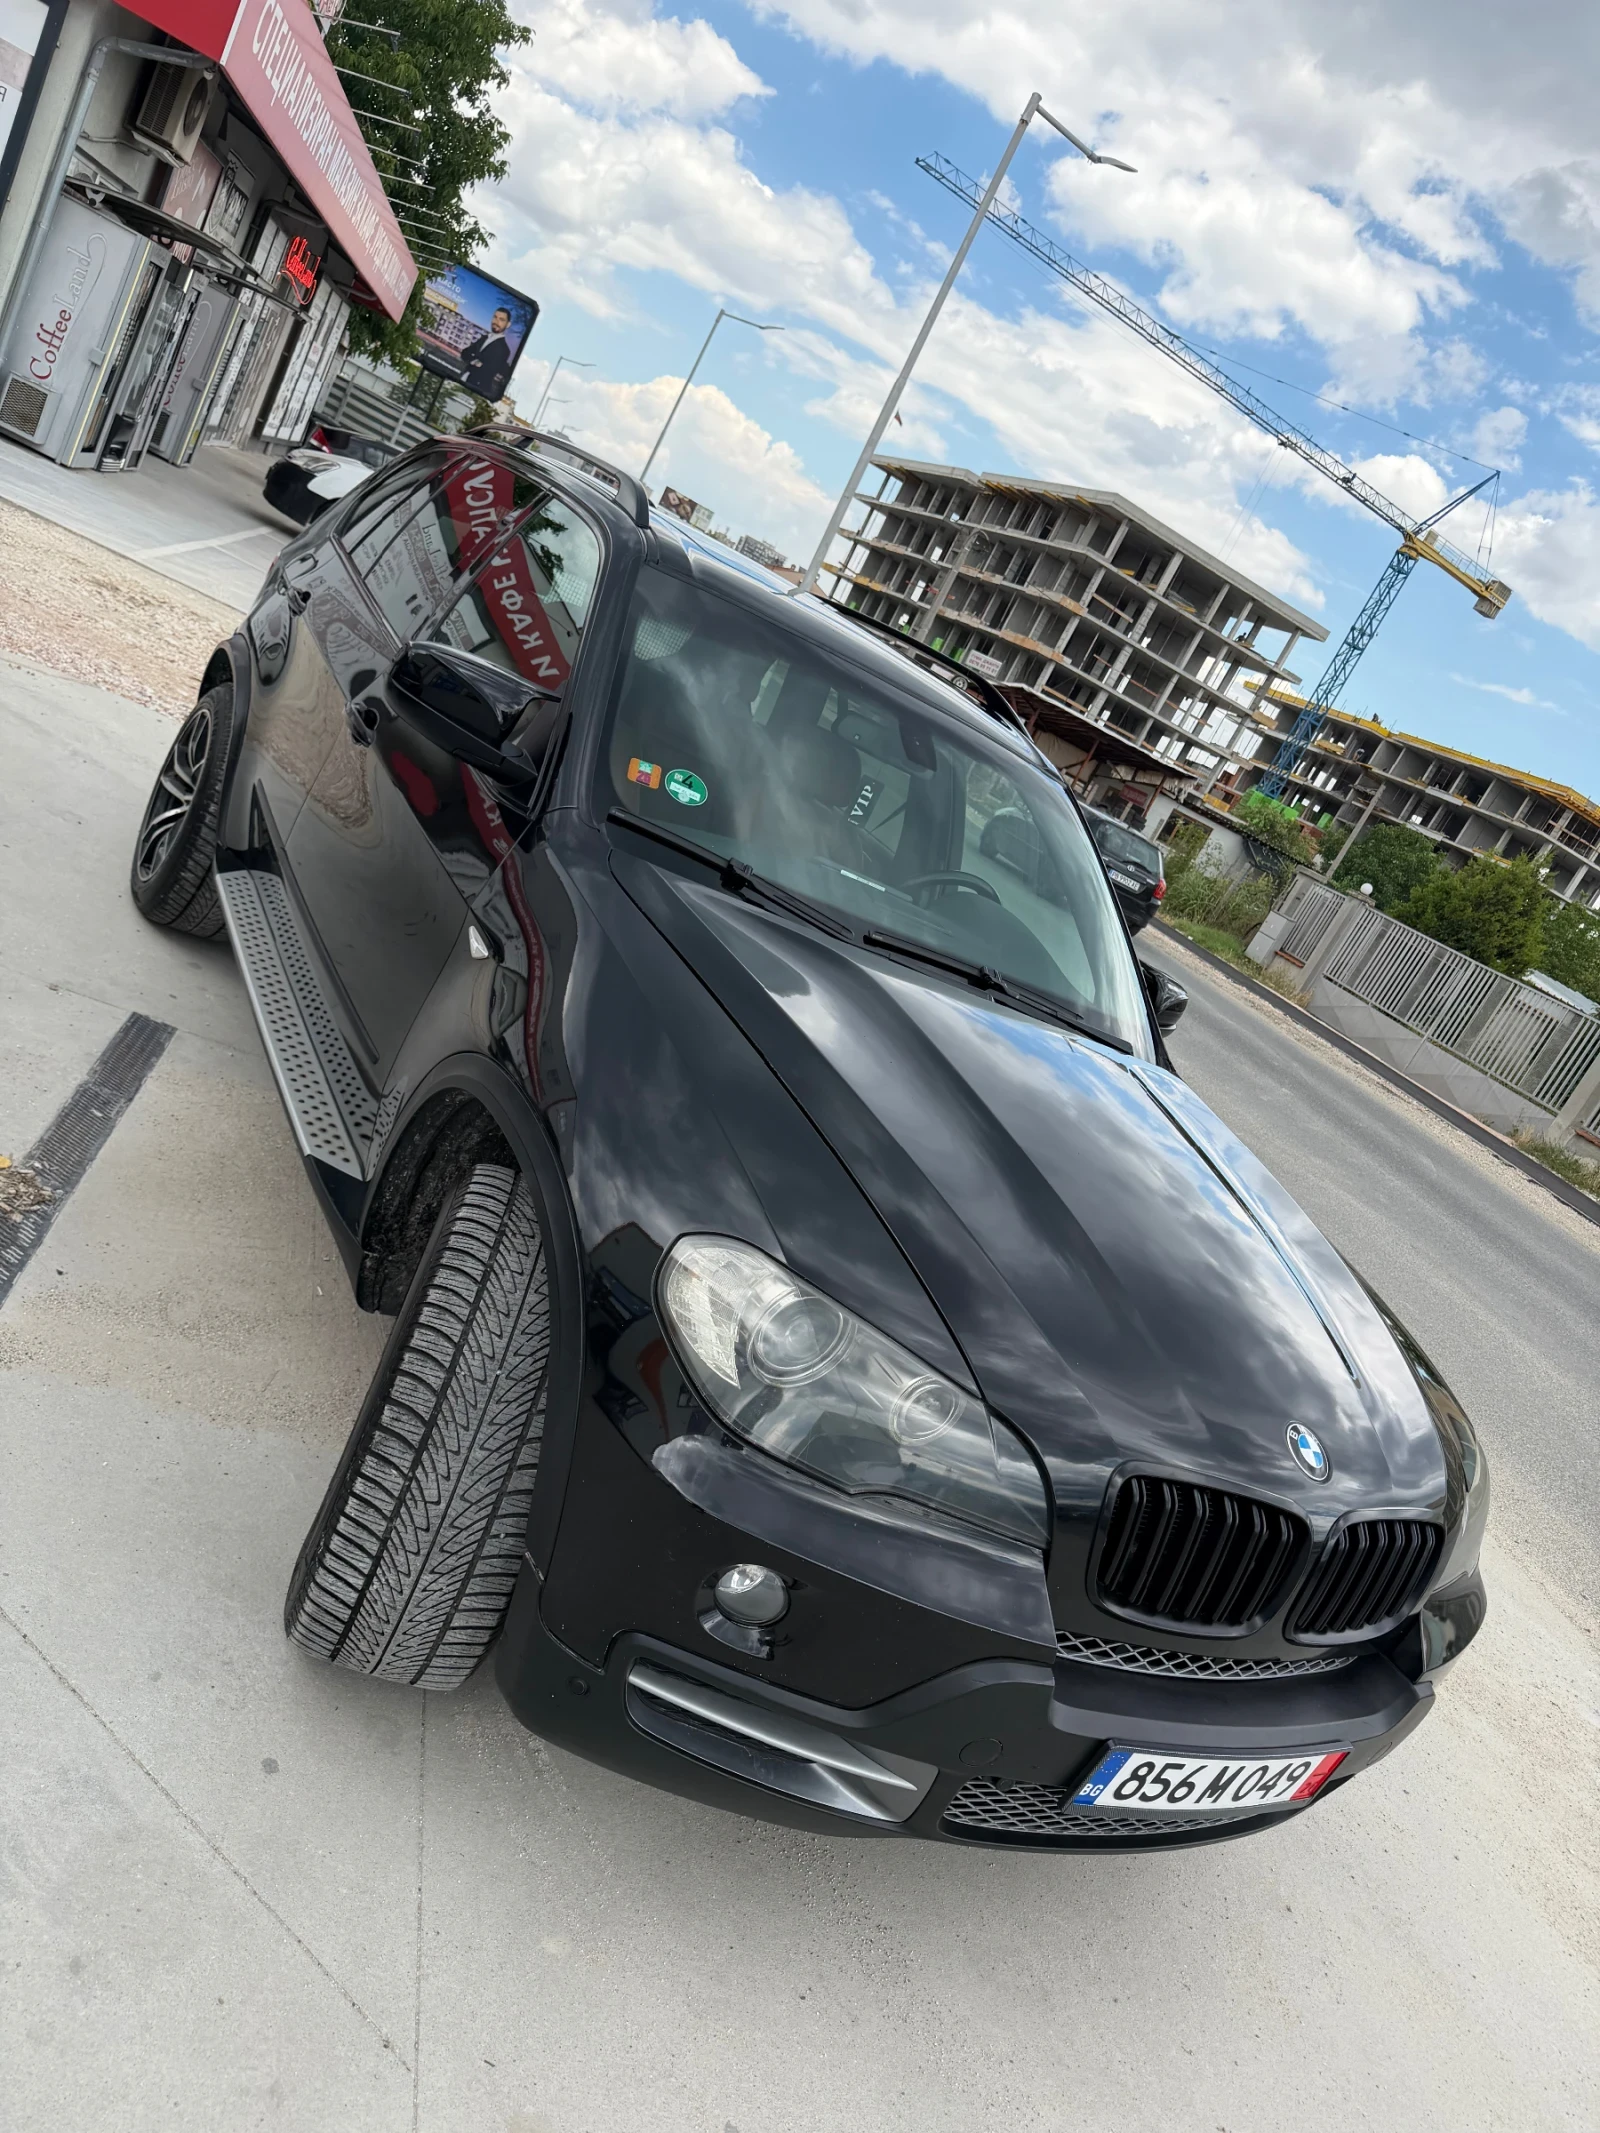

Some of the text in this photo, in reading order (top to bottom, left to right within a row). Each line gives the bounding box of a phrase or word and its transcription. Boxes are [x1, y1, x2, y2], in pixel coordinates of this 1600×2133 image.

[29, 245, 94, 381] CoffeeLand
[681, 774, 694, 789] 4
[850, 785, 874, 816] VIP
[1080, 1783, 1103, 1798] BG
[1113, 1761, 1311, 1804] 856 M 049
